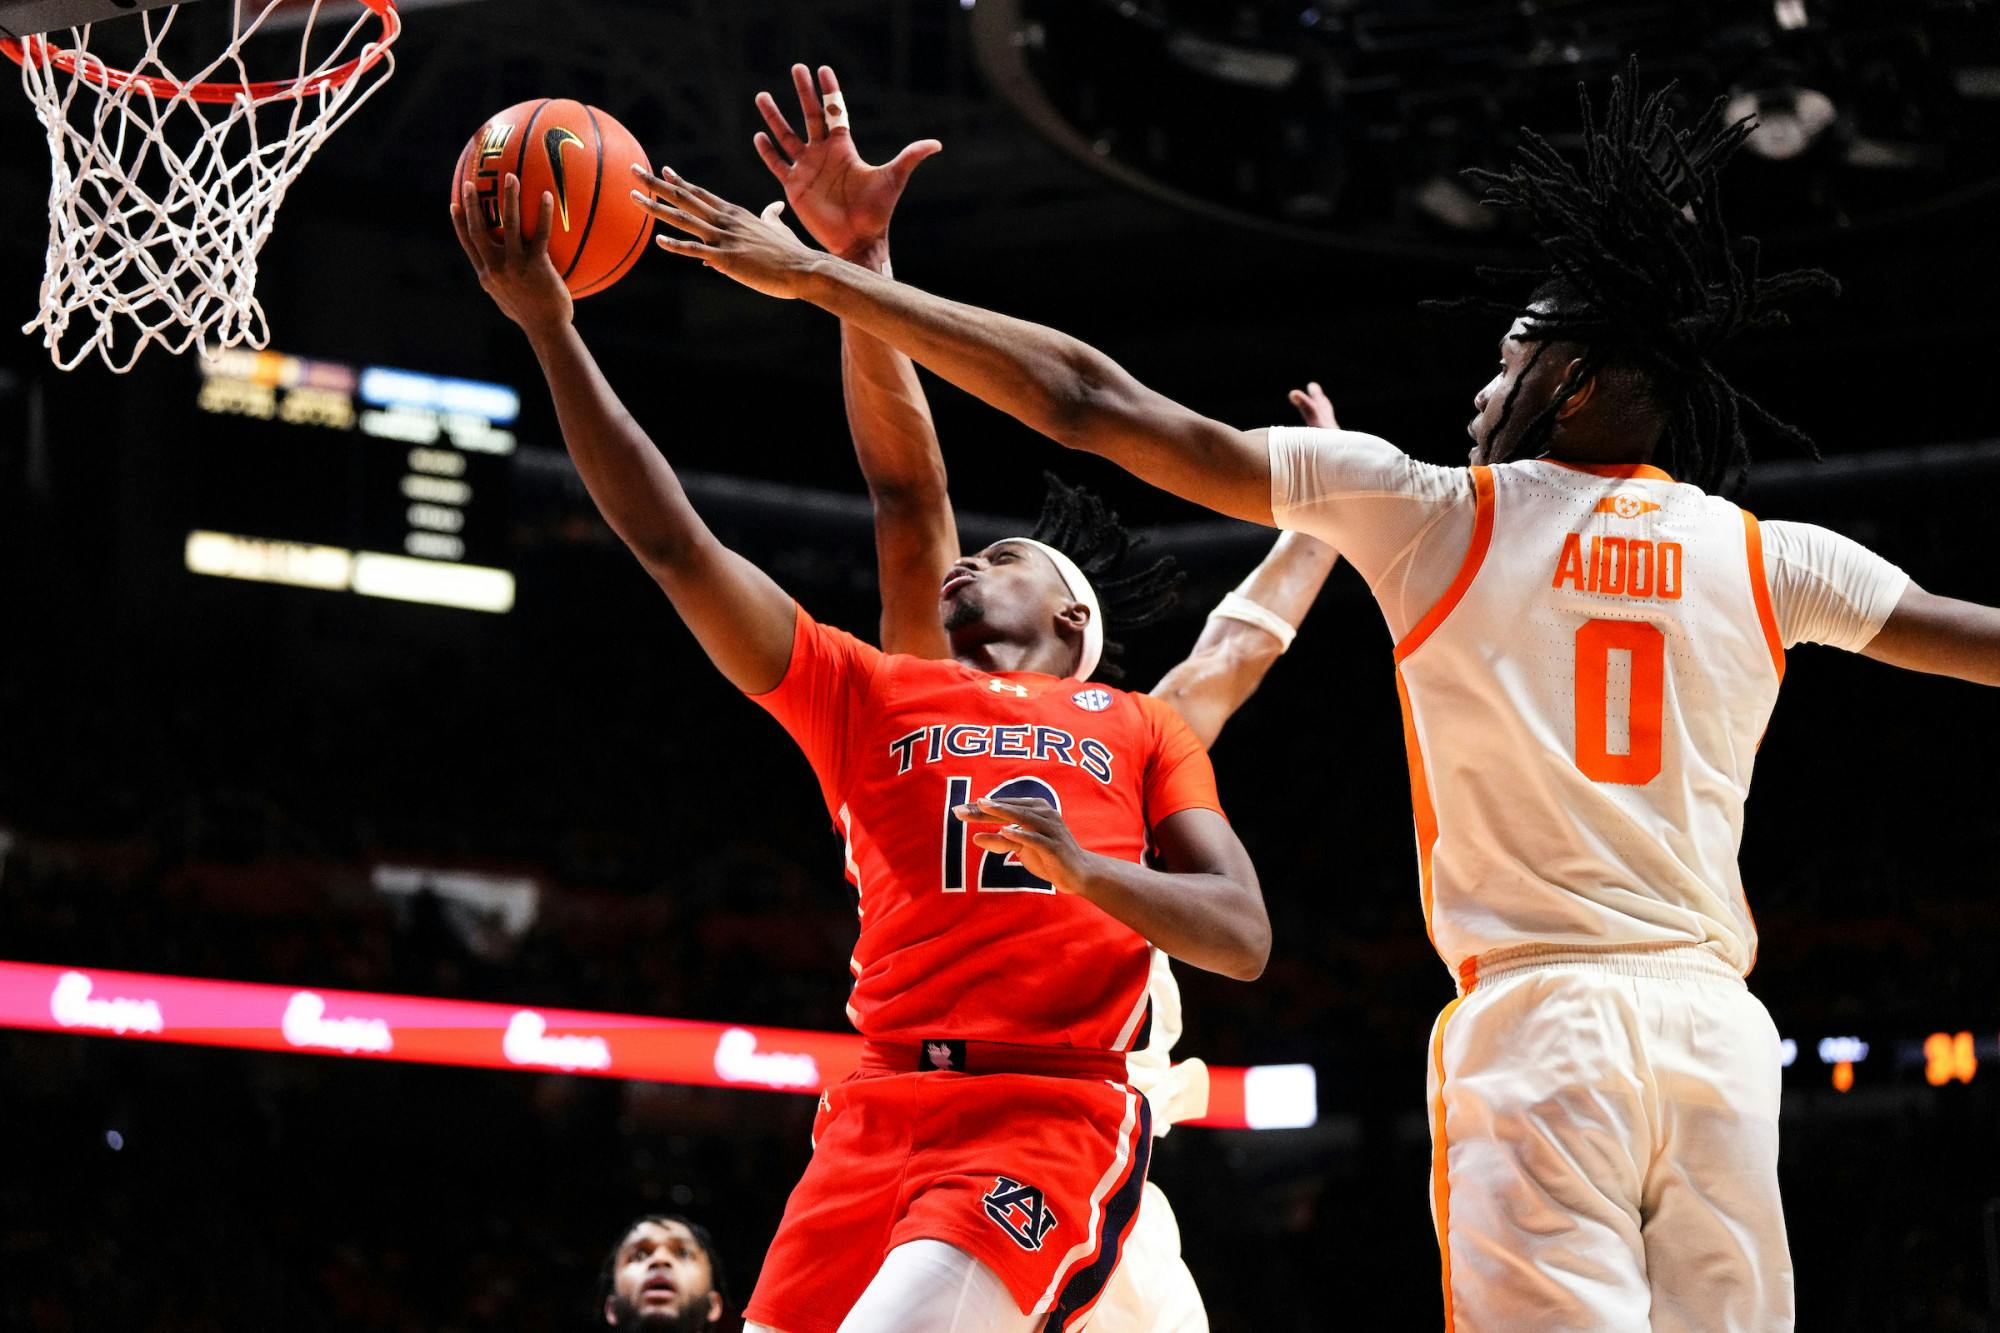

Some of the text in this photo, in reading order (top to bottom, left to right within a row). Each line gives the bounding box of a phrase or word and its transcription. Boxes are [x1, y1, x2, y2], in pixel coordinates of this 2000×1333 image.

[478, 124, 516, 228] ELITE
[1552, 532, 1683, 600] AIDOO
[1072, 687, 1113, 713] SEC
[1575, 617, 1665, 786] 0
[889, 723, 1114, 784] TIGERS
[941, 775, 1062, 895] 12
